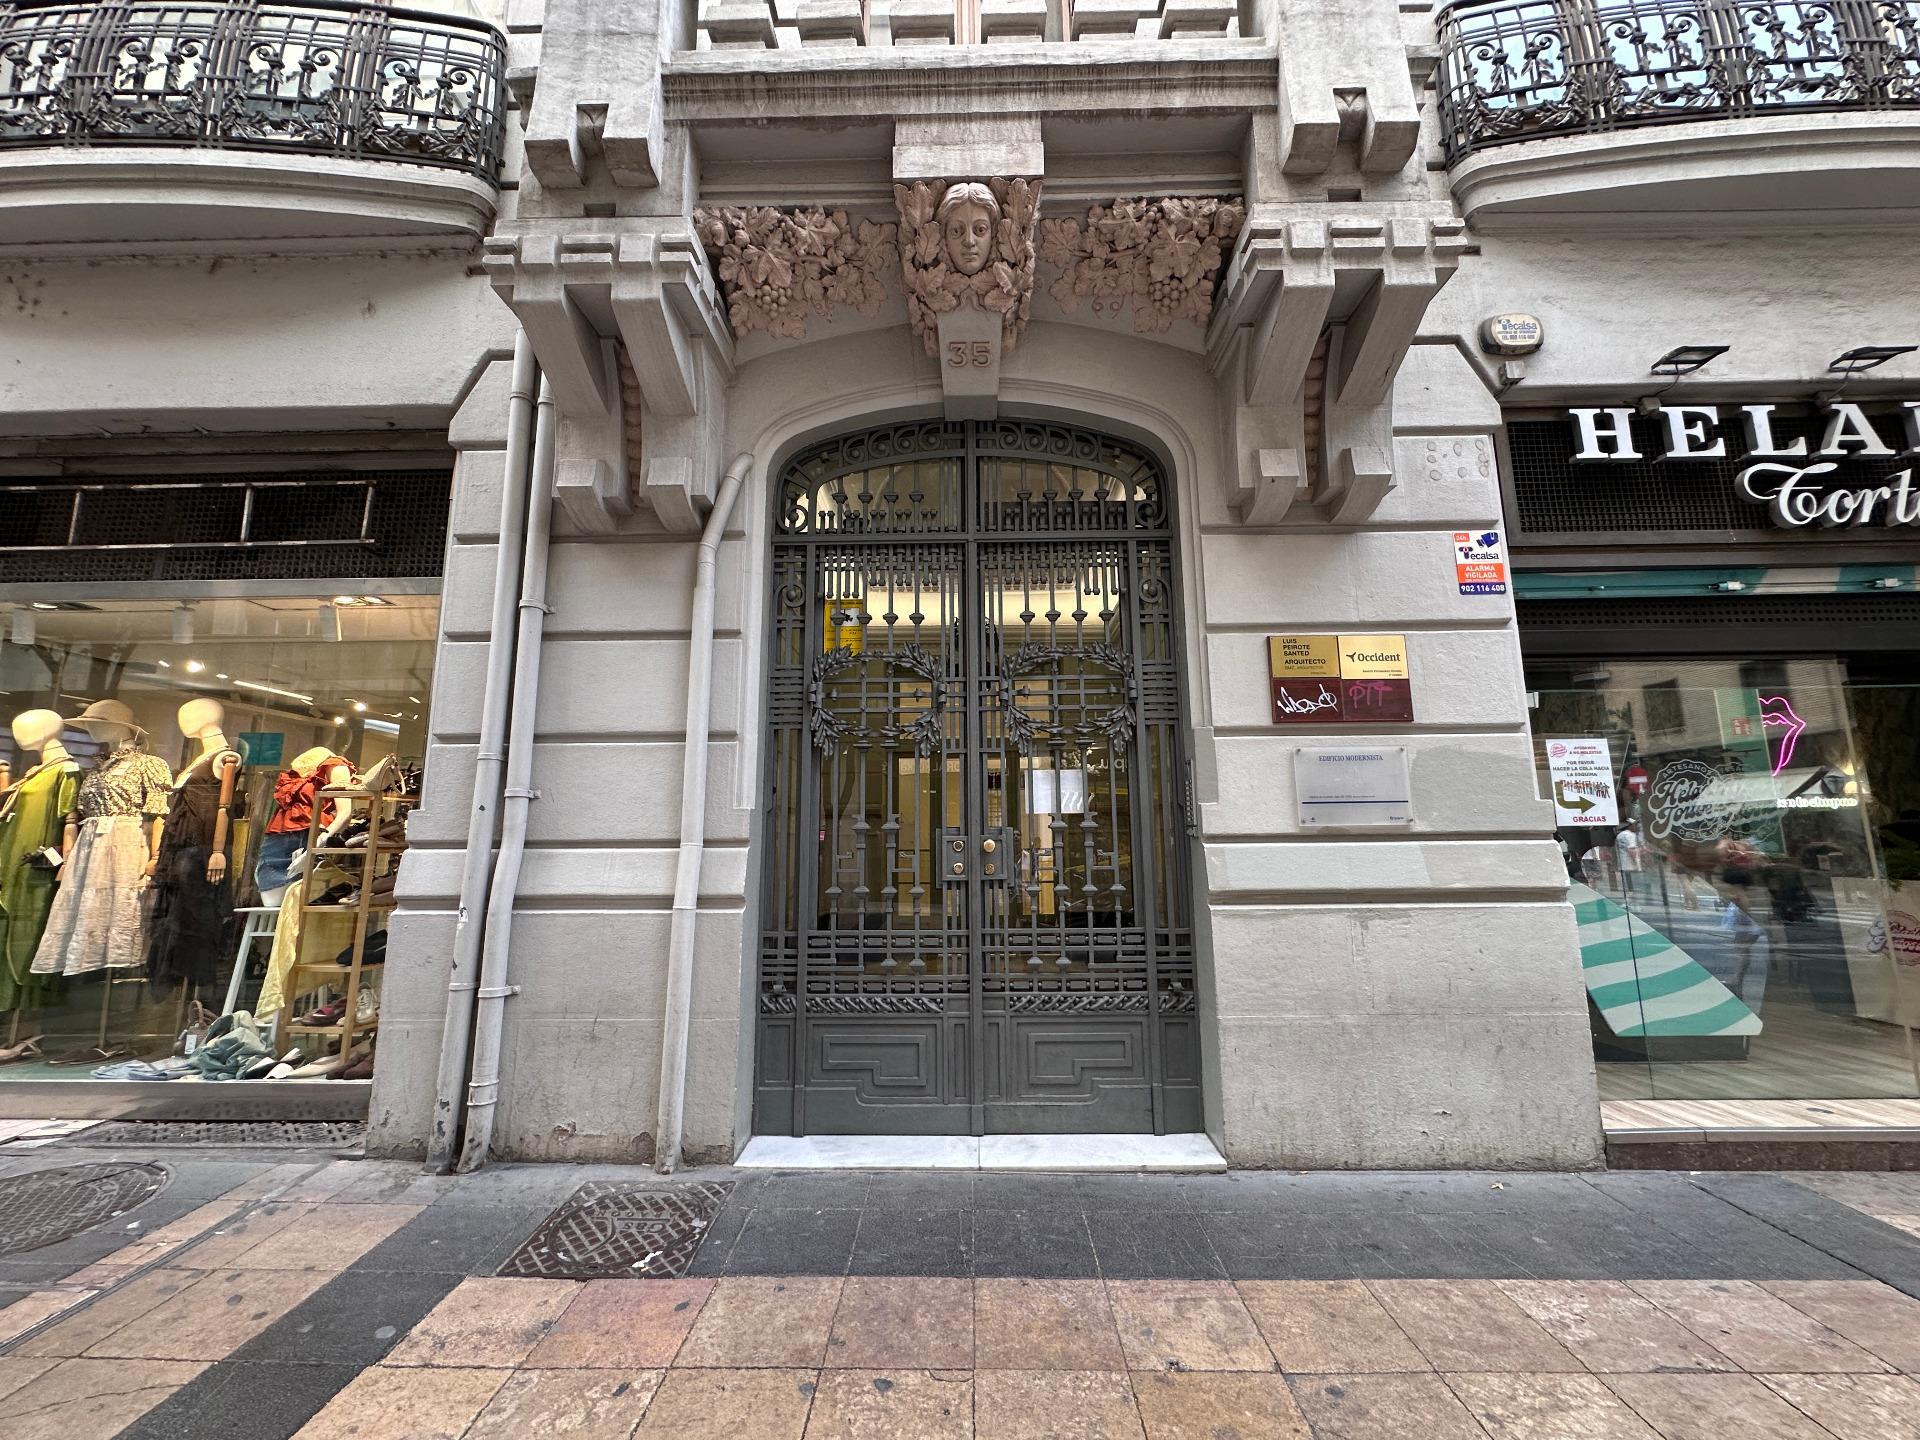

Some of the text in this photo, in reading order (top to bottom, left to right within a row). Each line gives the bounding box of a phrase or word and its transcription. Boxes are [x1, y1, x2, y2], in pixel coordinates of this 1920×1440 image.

[948, 341, 992, 367] 35
[1569, 401, 1920, 459] HELA
[1458, 546, 1499, 560] Tecalsa
[1358, 652, 1401, 662] Occident
[1572, 815, 1607, 823] GRACIAS
